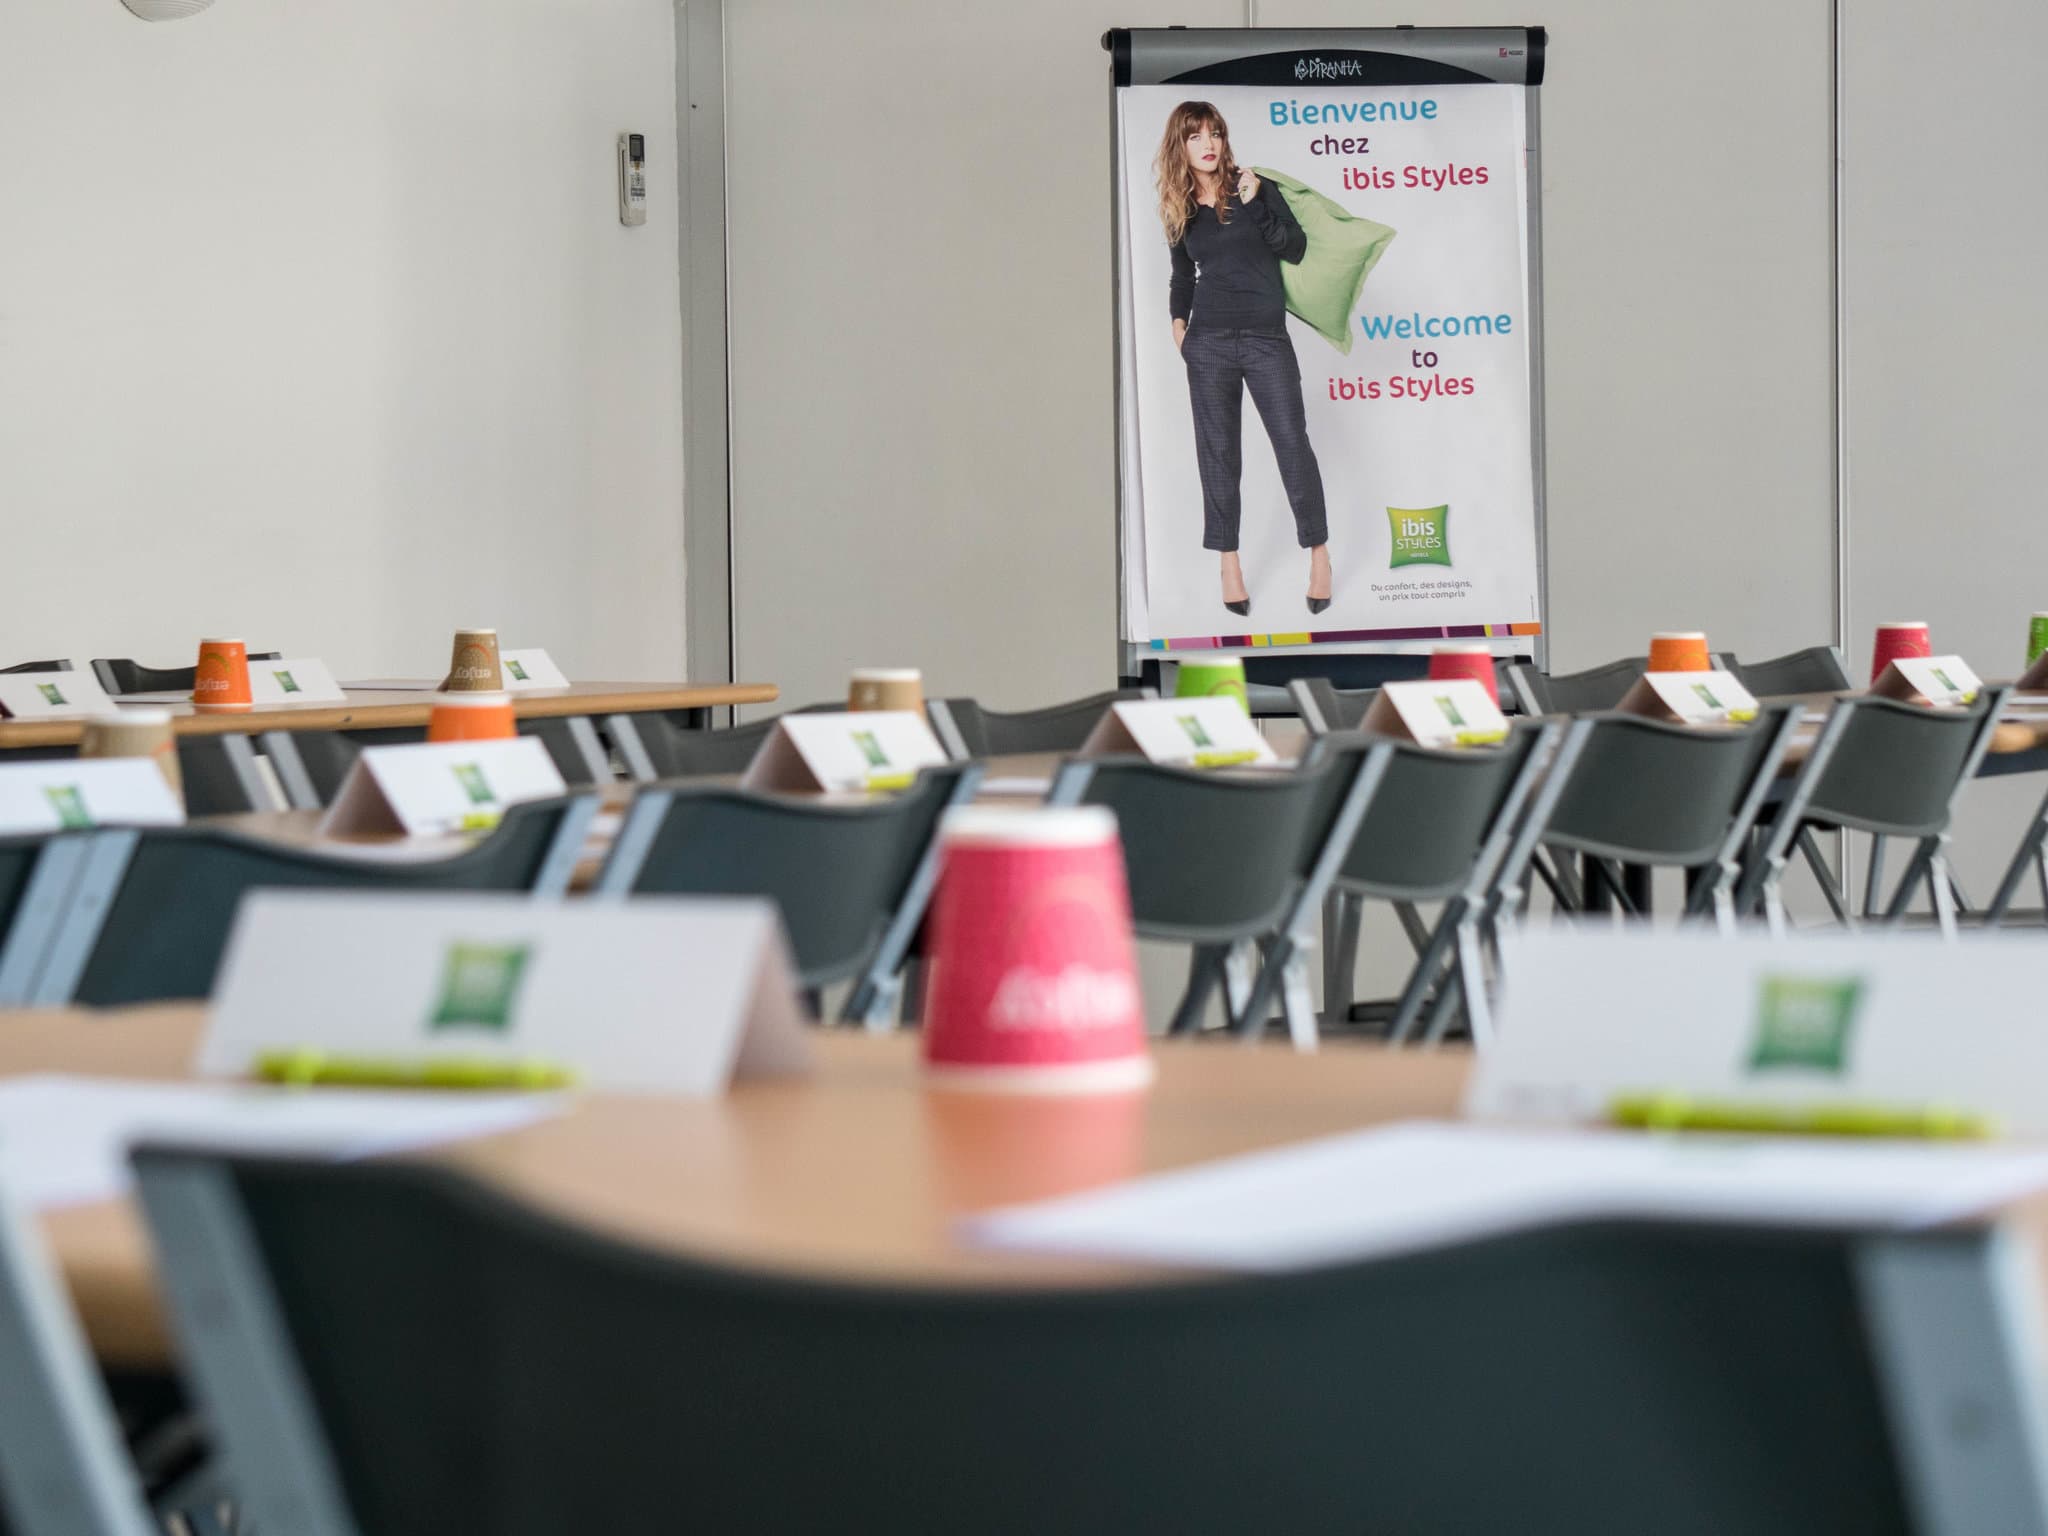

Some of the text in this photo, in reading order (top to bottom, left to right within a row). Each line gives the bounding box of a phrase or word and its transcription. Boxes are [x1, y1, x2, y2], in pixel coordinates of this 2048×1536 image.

[1269, 99, 1437, 126] Bienvenue
[1310, 134, 1369, 155] chez
[1343, 163, 1489, 191] ibis Styles
[1361, 312, 1512, 340] Welcome
[1412, 349, 1438, 368] to
[1328, 374, 1475, 401] ibis Styles
[1402, 518, 1435, 537] ibis
[1384, 582, 1418, 591] confort,
[1436, 580, 1472, 589] designs,
[1392, 593, 1409, 601] prix
[1411, 592, 1429, 600] tout
[1431, 590, 1465, 599] compris
